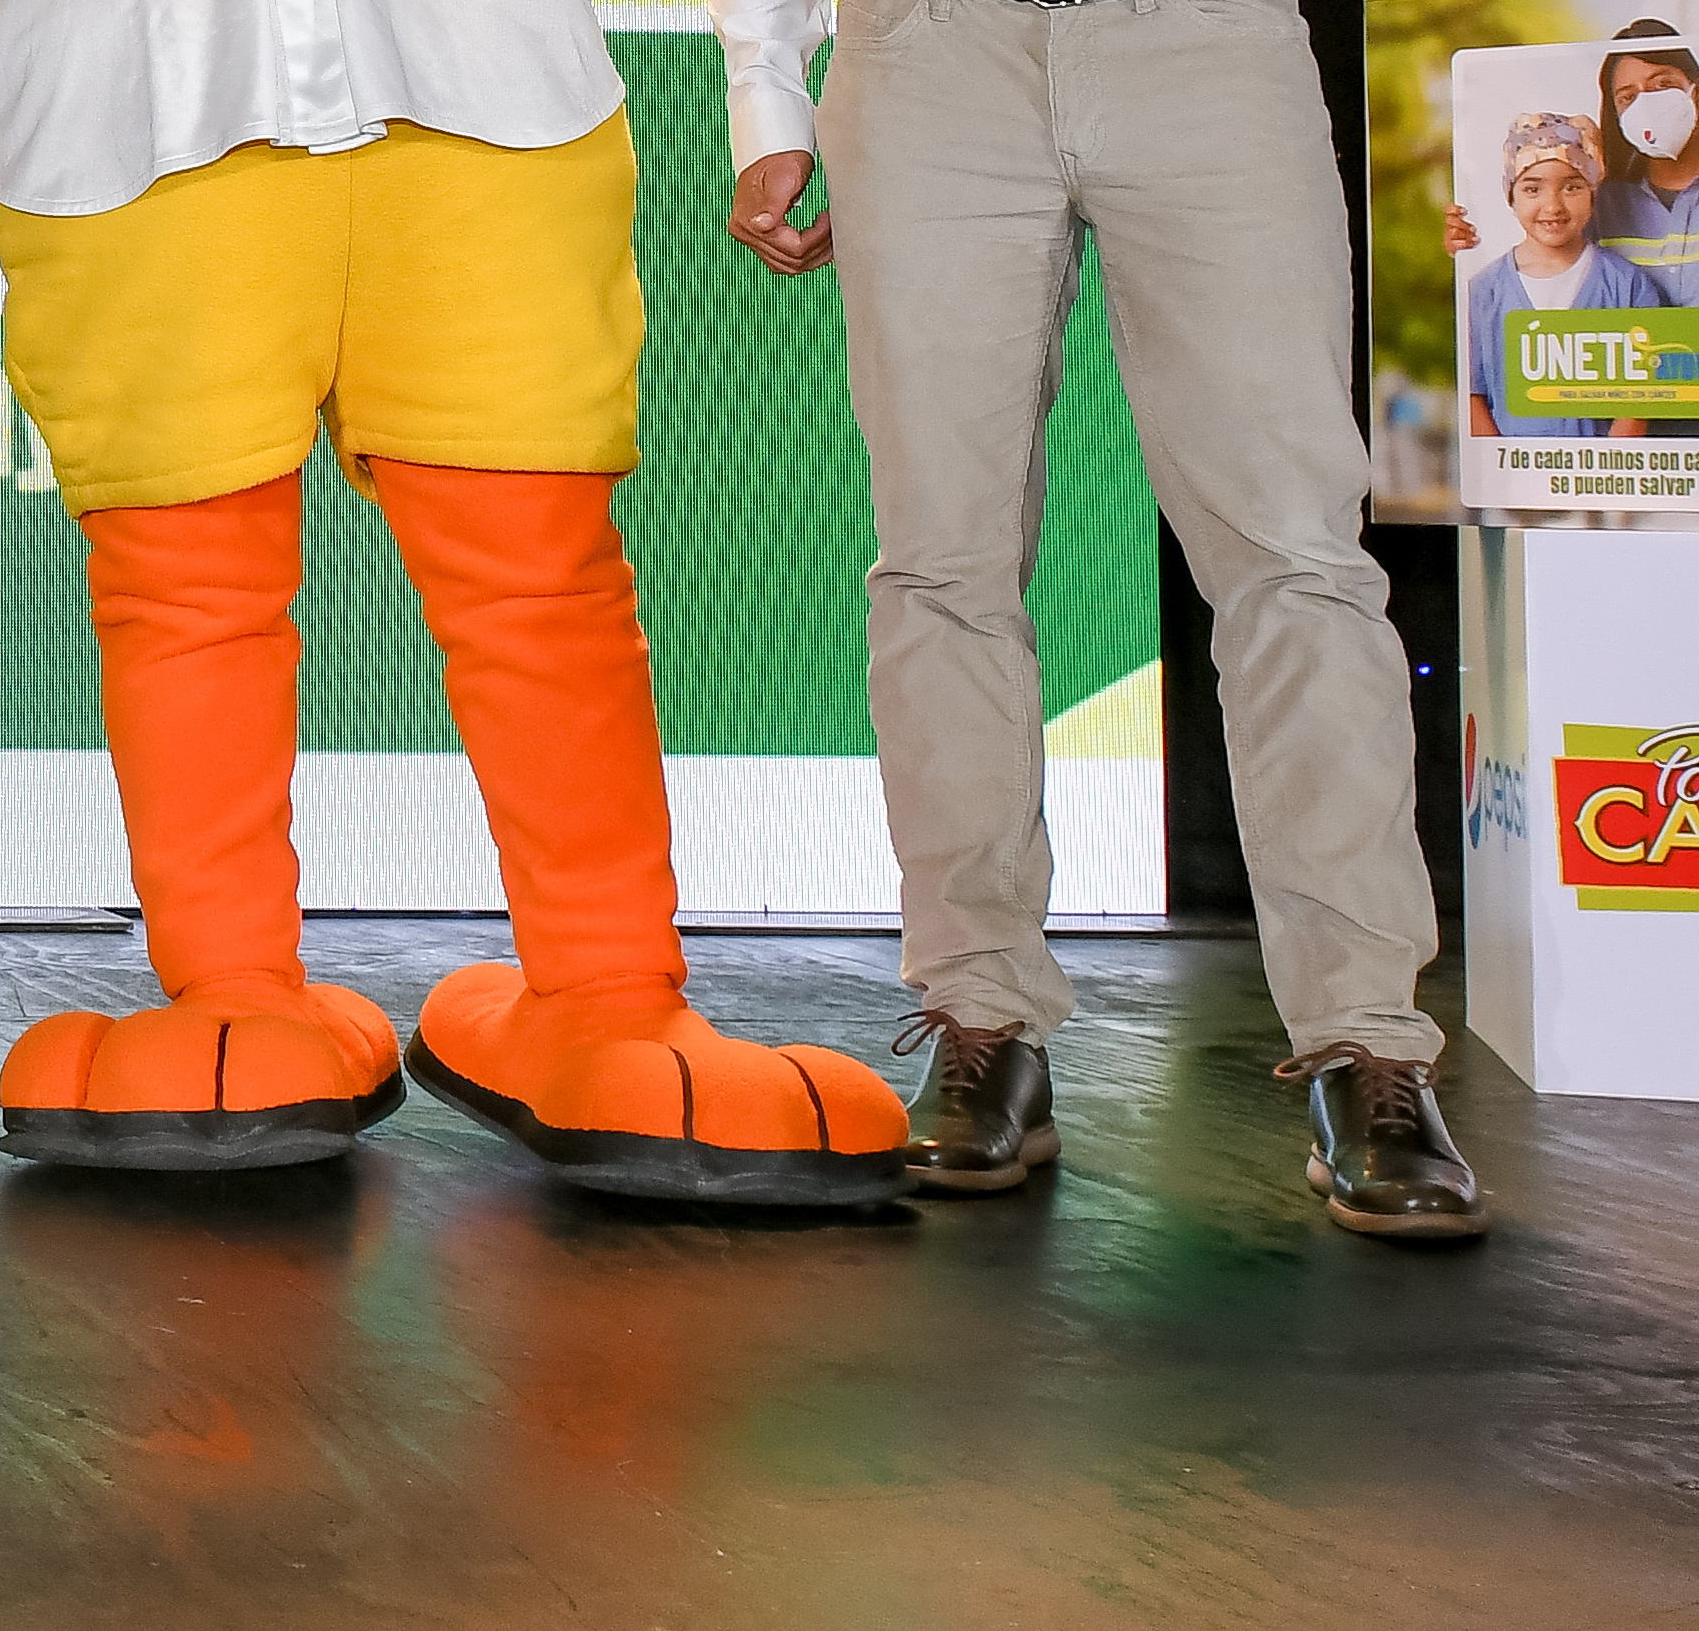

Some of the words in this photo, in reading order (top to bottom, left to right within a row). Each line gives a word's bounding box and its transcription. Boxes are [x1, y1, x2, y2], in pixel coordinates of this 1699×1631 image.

[1520, 319, 1649, 381] ÚNETE
[1497, 448, 1506, 469] 7
[1510, 448, 1530, 469] de
[1534, 449, 1573, 470] cada
[1577, 449, 1594, 469] 10
[1649, 452, 1680, 471] con
[1550, 475, 1570, 495] se
[1574, 474, 1635, 496] pueden
[1640, 474, 1695, 496] salvar
